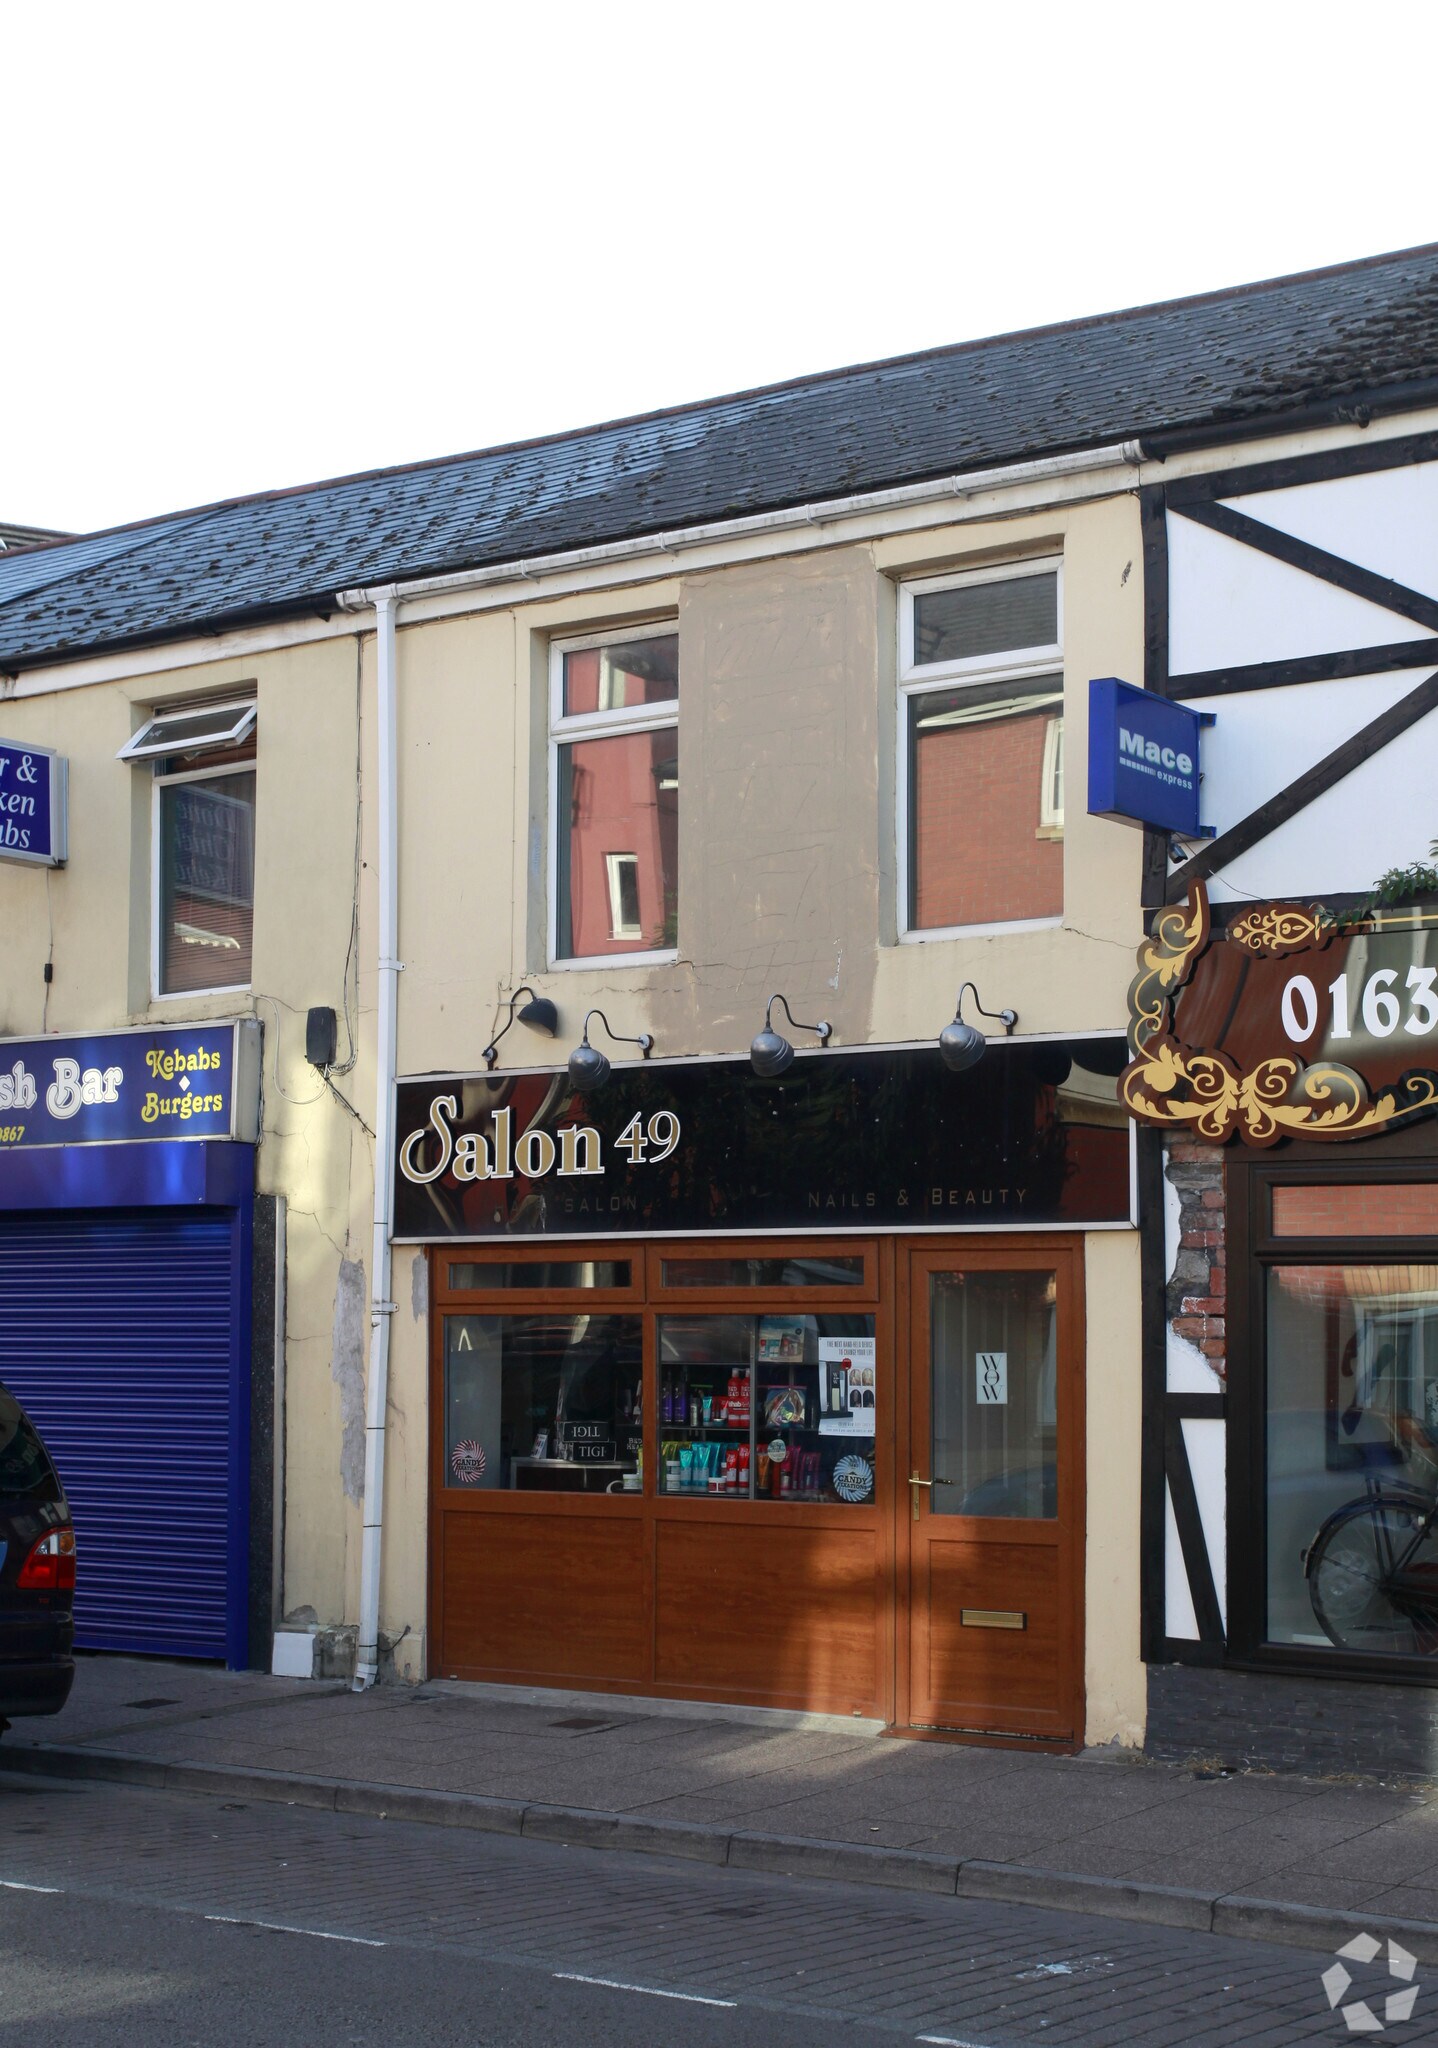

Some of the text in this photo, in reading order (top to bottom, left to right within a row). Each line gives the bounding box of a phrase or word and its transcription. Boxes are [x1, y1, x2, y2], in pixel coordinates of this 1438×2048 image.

[1120, 727, 1192, 775] Mace
[16, 754, 38, 784] &
[1157, 769, 1193, 790] express
[1281, 965, 1438, 1043] 0163
[145, 1046, 221, 1081] Kebabs
[46, 1058, 123, 1120] Bar
[141, 1092, 222, 1123] Burgers
[399, 1095, 681, 1184] Salon 49
[564, 1195, 637, 1213] SALON
[808, 1191, 876, 1208] NAILS
[897, 1188, 909, 1206] &
[579, 1446, 605, 1457] TIGI
[837, 1475, 868, 1484] CANDY
